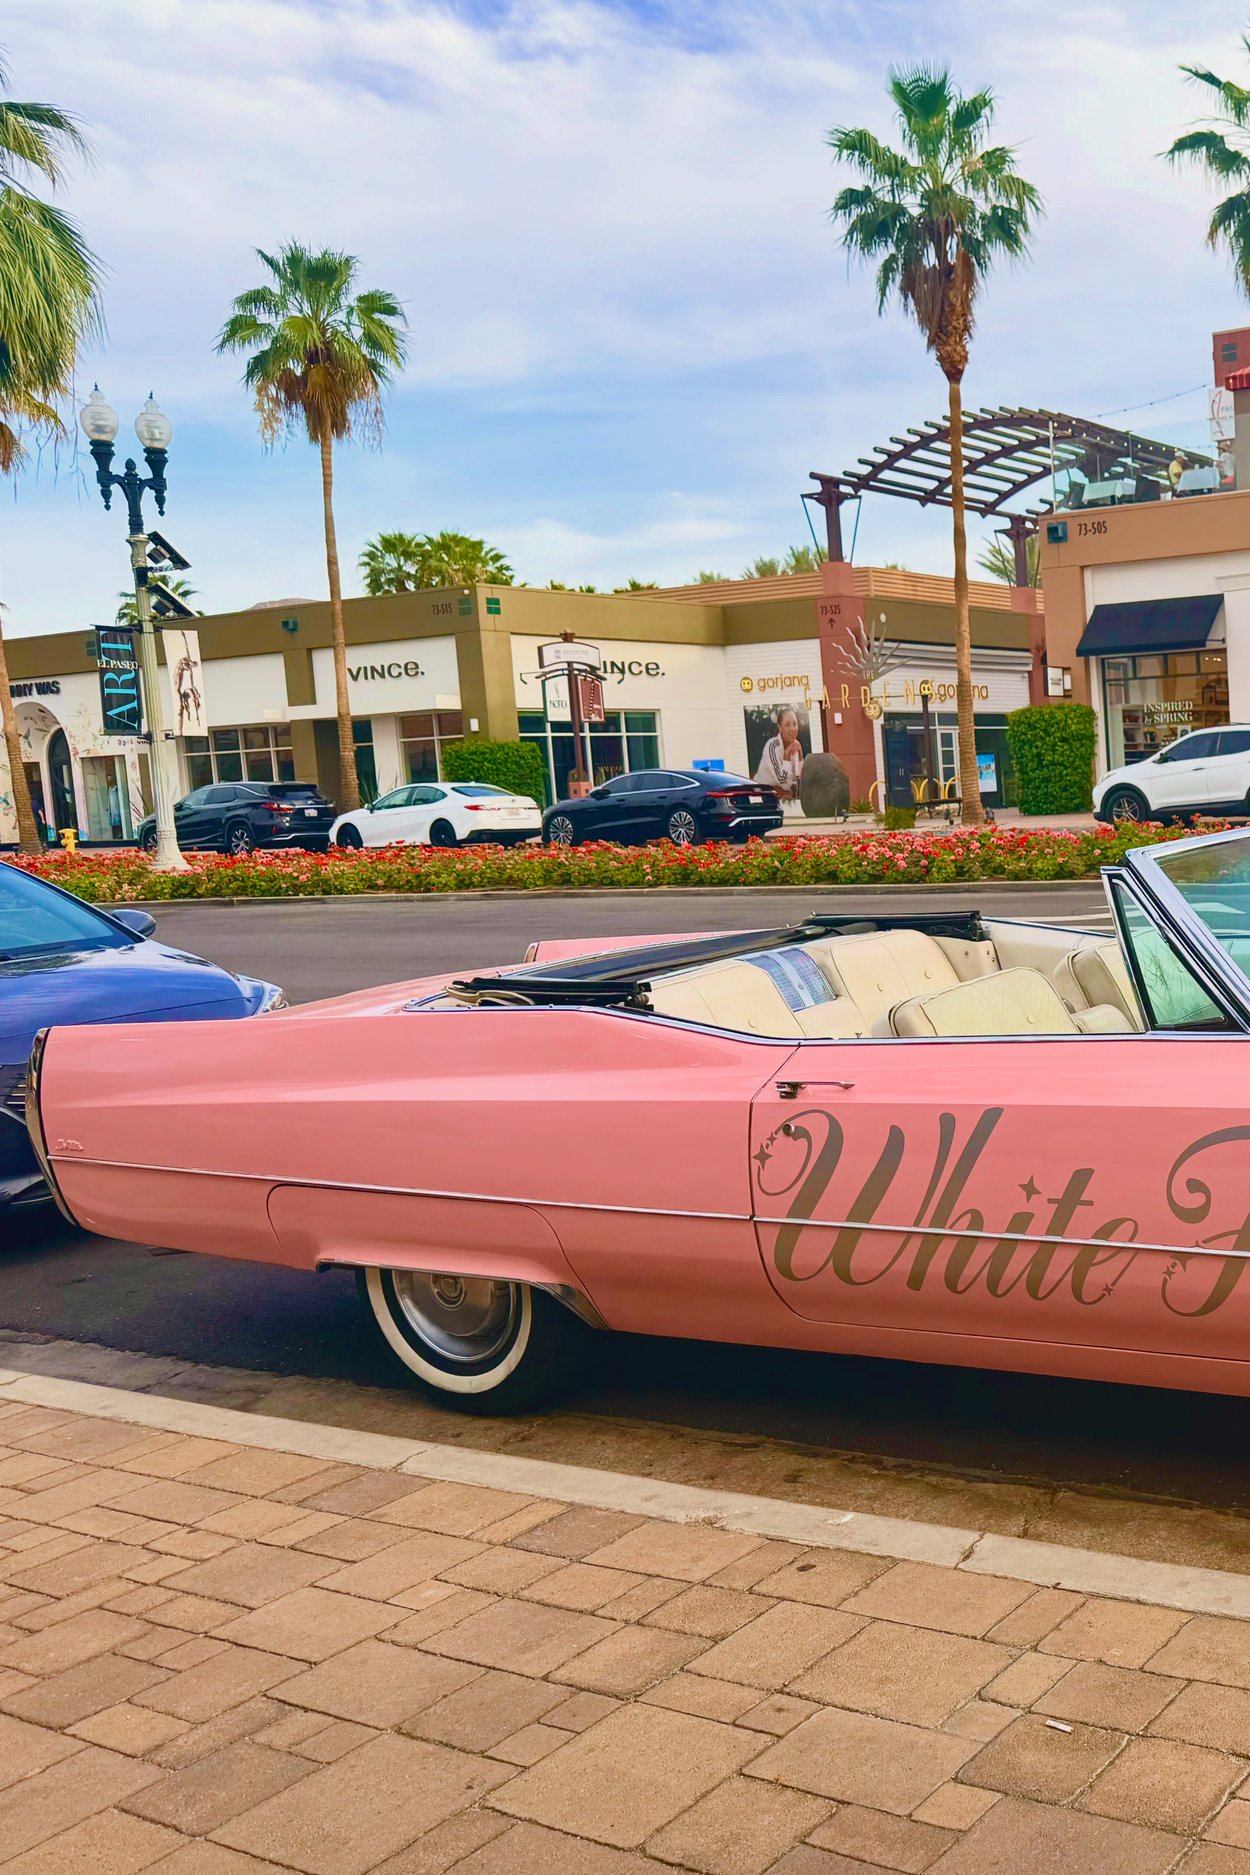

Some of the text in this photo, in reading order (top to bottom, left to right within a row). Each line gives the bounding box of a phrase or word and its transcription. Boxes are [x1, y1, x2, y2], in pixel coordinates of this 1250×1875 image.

[1077, 520, 1108, 536] 73-505
[820, 604, 841, 615] 73-525
[97, 659, 138, 669] EL PASEO
[34, 680, 61, 696] WAS
[99, 631, 138, 730] ART
[757, 674, 810, 692] gorjana
[1143, 700, 1193, 713] INSPIRED
[1153, 711, 1193, 724] SPRING
[757, 1107, 1139, 1305] White
